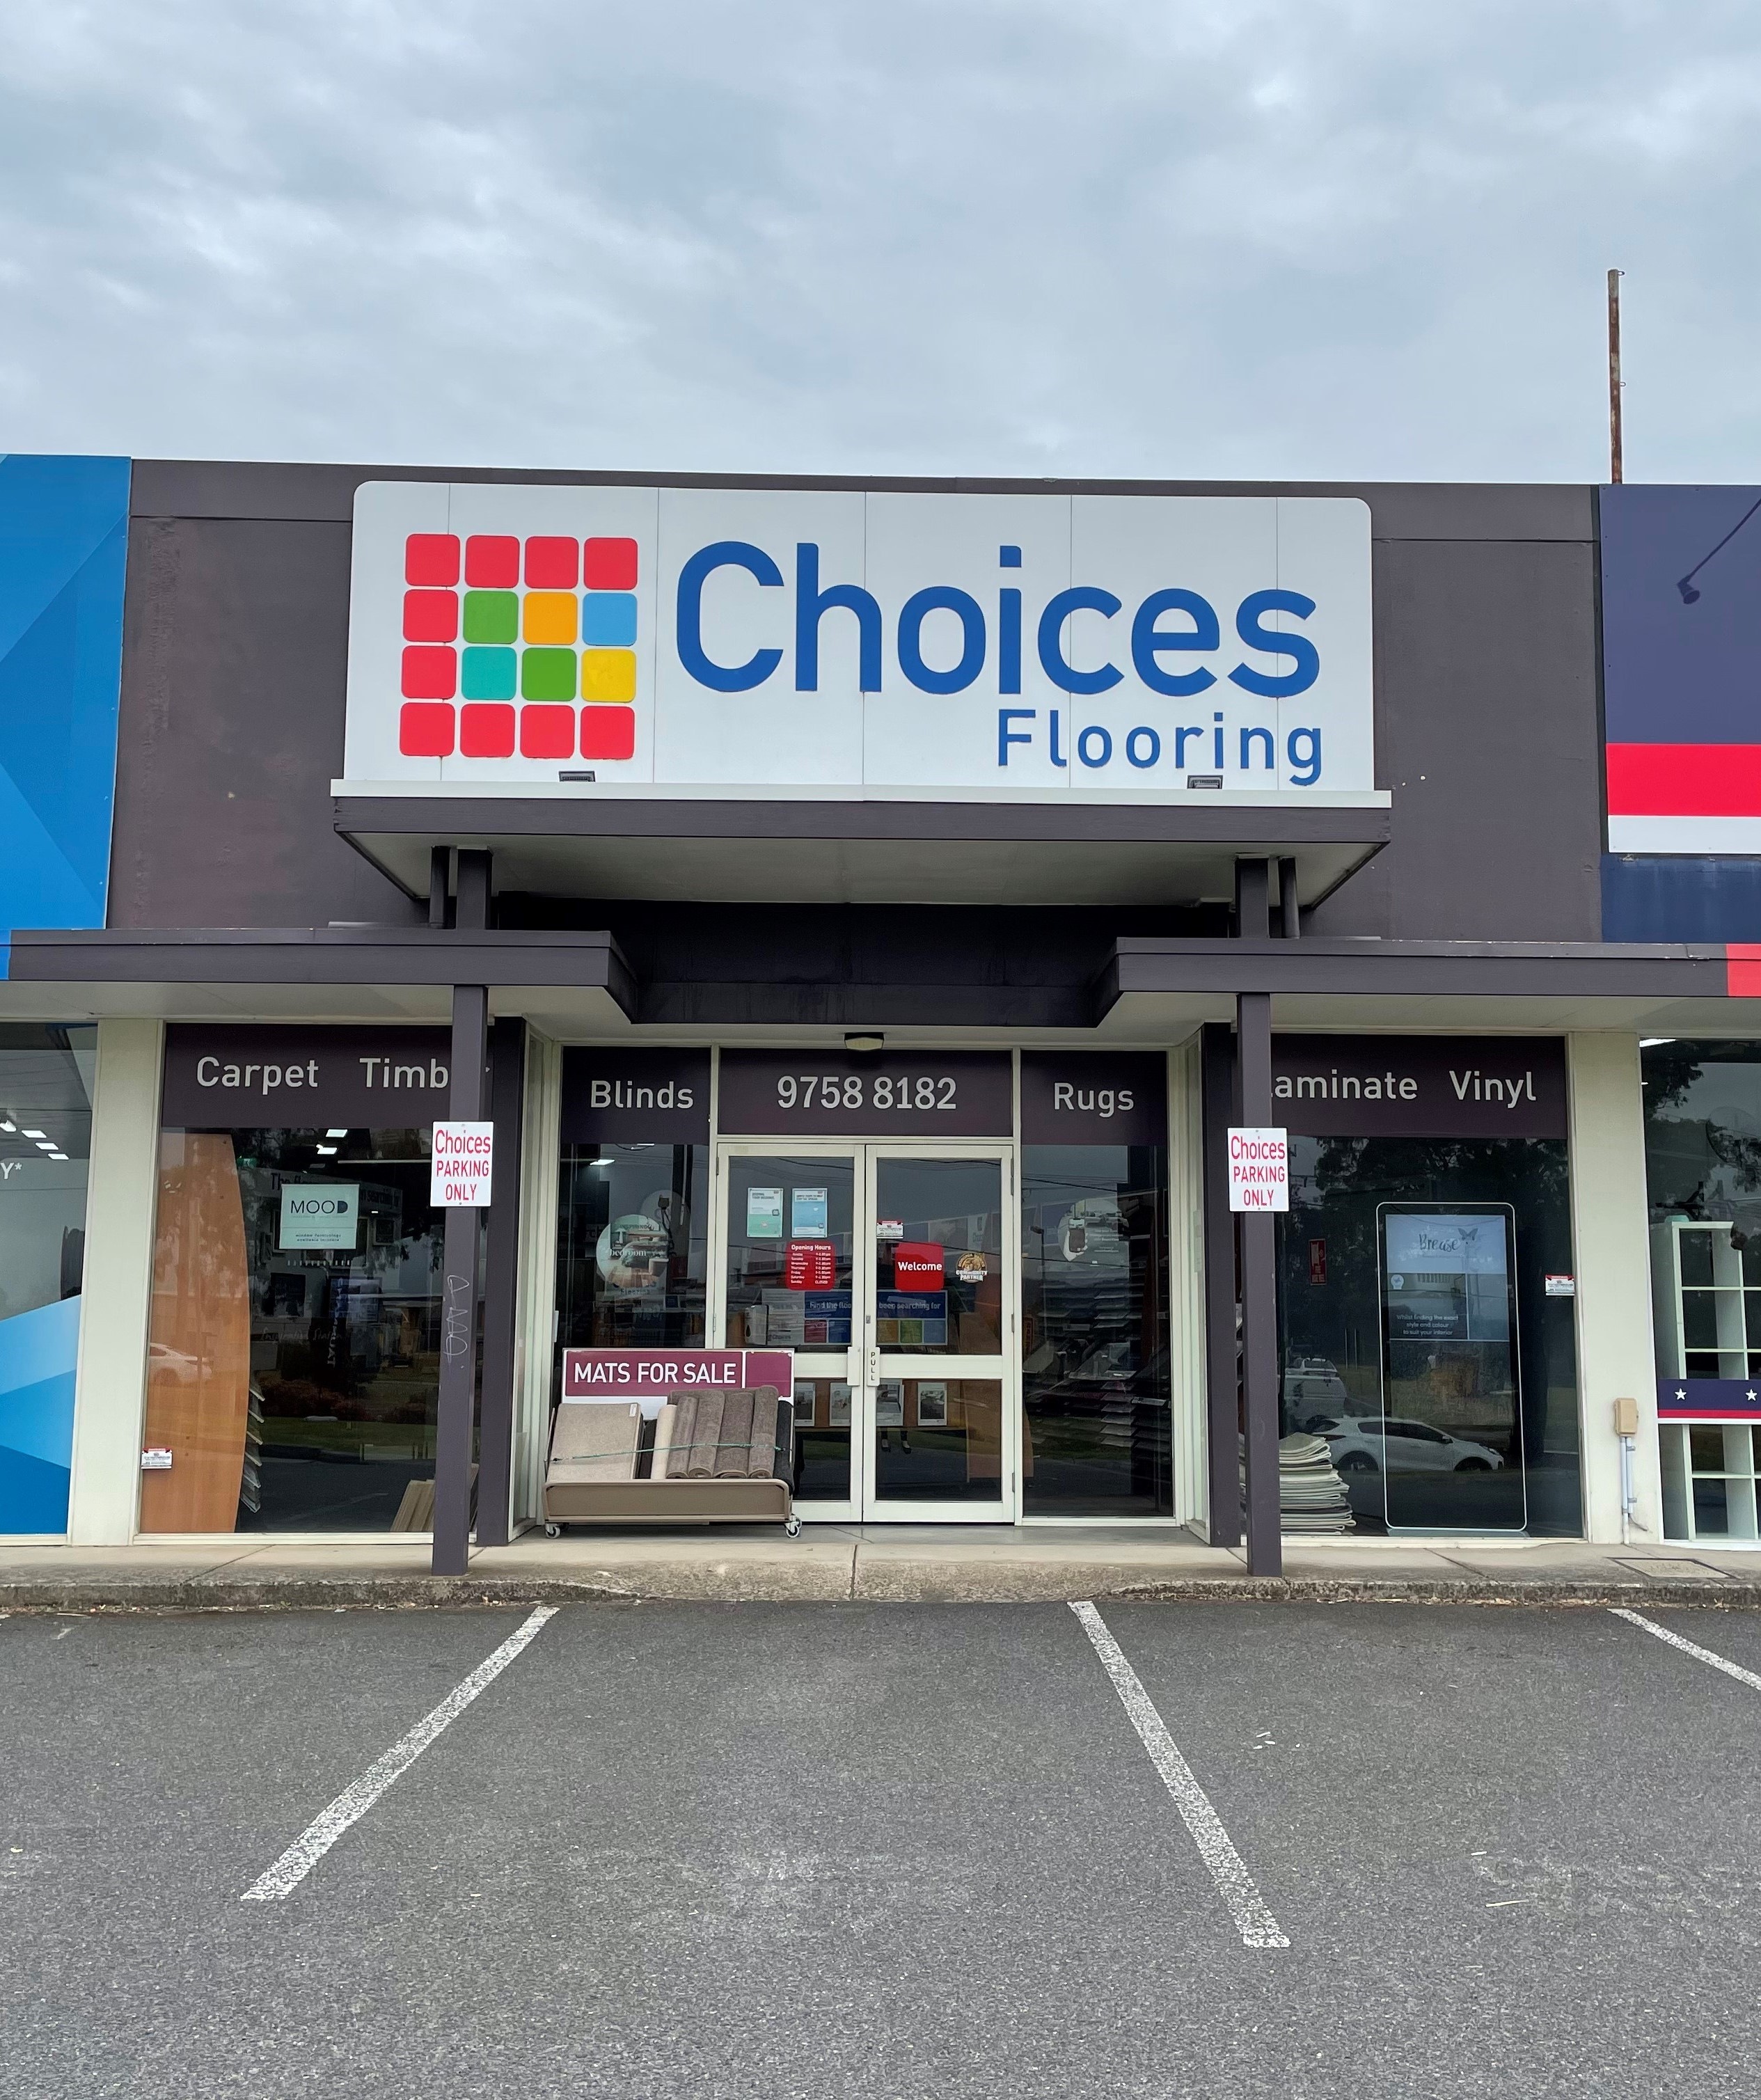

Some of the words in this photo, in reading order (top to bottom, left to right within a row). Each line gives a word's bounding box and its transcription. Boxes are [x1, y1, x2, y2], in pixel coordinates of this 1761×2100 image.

[677, 541, 1320, 698] Choices
[998, 709, 1322, 787] Flooring
[196, 1056, 319, 1096] Carpet
[358, 1057, 490, 1089] Timb
[1270, 1069, 1419, 1100] aminate
[590, 1080, 694, 1109] Blinds
[777, 1075, 863, 1110] 9758
[873, 1076, 957, 1110] 8182
[1053, 1082, 1135, 1118] Rugs
[1449, 1071, 1537, 1109] Vinyl
[435, 1129, 491, 1155] Choices
[1230, 1135, 1286, 1160] Choices
[436, 1160, 490, 1178] PARKING
[1233, 1165, 1286, 1183] PARKING
[445, 1183, 477, 1201] ONLY
[1243, 1189, 1274, 1206] ONLY
[290, 1200, 348, 1214] MOOD
[897, 1261, 943, 1272] Welcome
[897, 1302, 930, 1311] searching
[1414, 1313, 1433, 1322] finding
[574, 1361, 631, 1384] MATS
[637, 1362, 679, 1384] FOR
[682, 1362, 737, 1384] SALE
